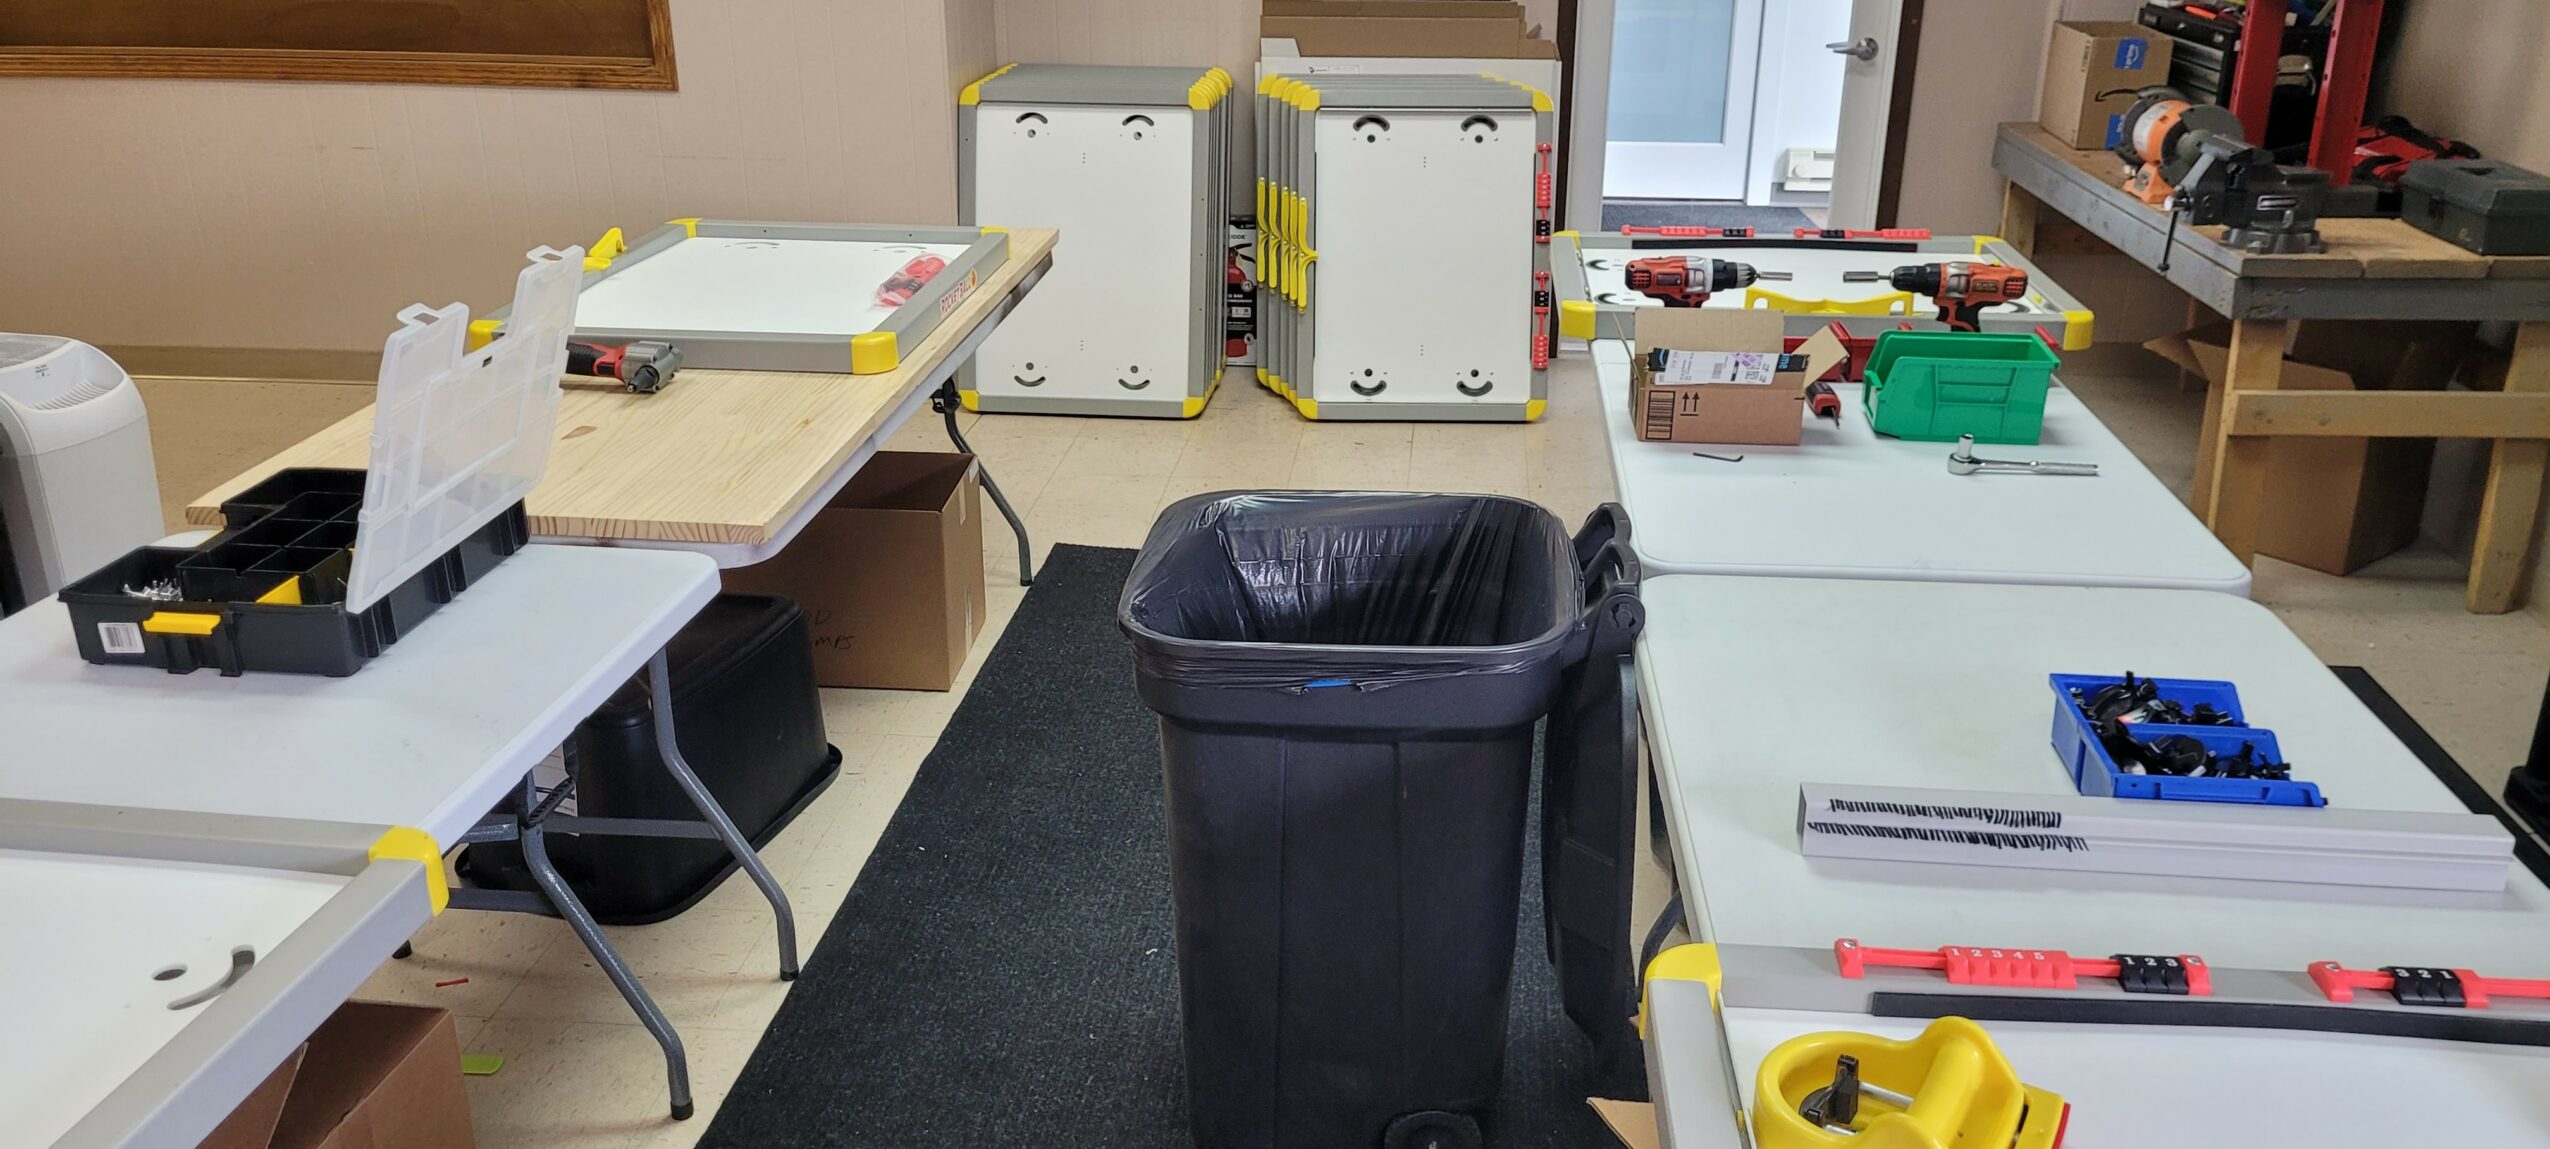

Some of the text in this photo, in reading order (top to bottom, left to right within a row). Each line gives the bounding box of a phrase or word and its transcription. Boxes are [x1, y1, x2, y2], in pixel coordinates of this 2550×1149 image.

[1951, 948, 2045, 961] 1 2 3 4 5
[2124, 956, 2178, 967] 1 2 3
[2394, 969, 2453, 979] 3 2 1
